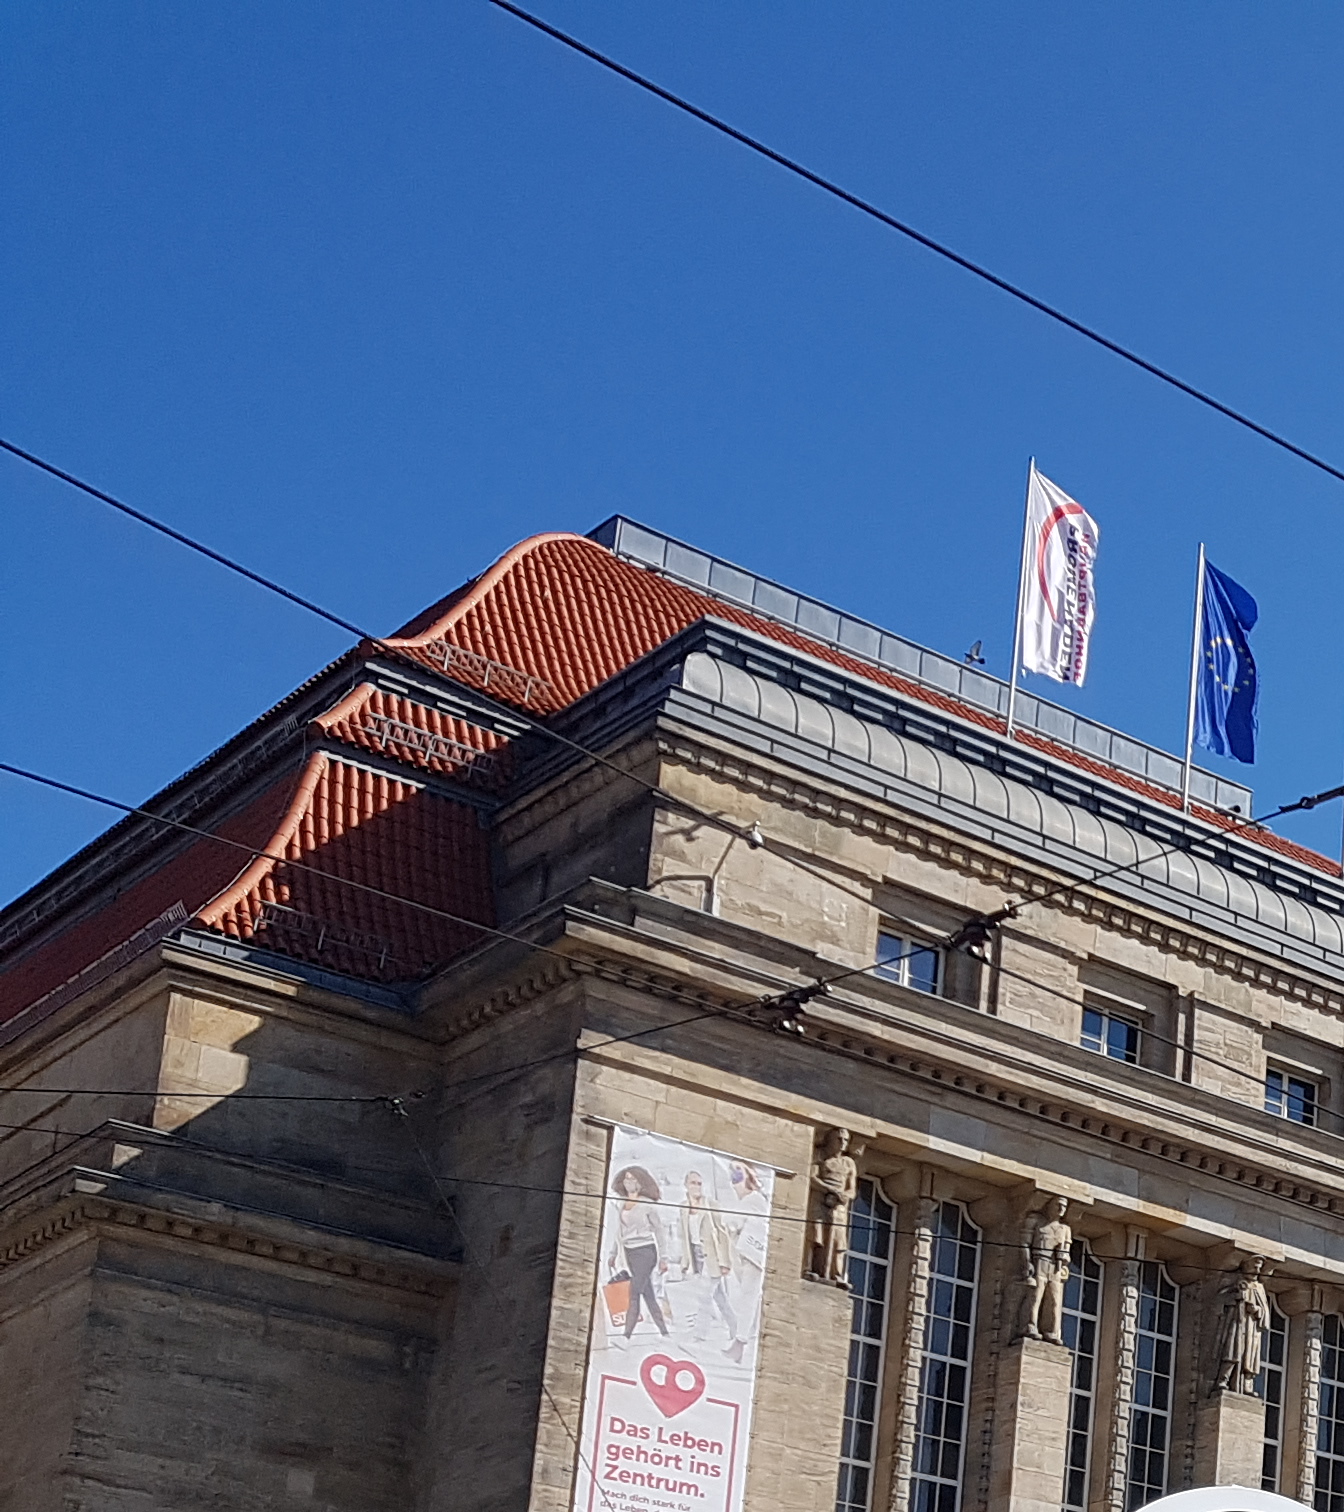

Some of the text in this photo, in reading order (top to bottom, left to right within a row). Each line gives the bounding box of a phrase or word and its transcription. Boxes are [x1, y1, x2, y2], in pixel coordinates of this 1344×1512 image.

[609, 1416, 723, 1455] Das Leben
[606, 1443, 721, 1478] gehört ins
[603, 1463, 705, 1498] Zentrum.
[600, 1500, 617, 1509] das
[602, 1489, 691, 1512] Mach dich stark für
